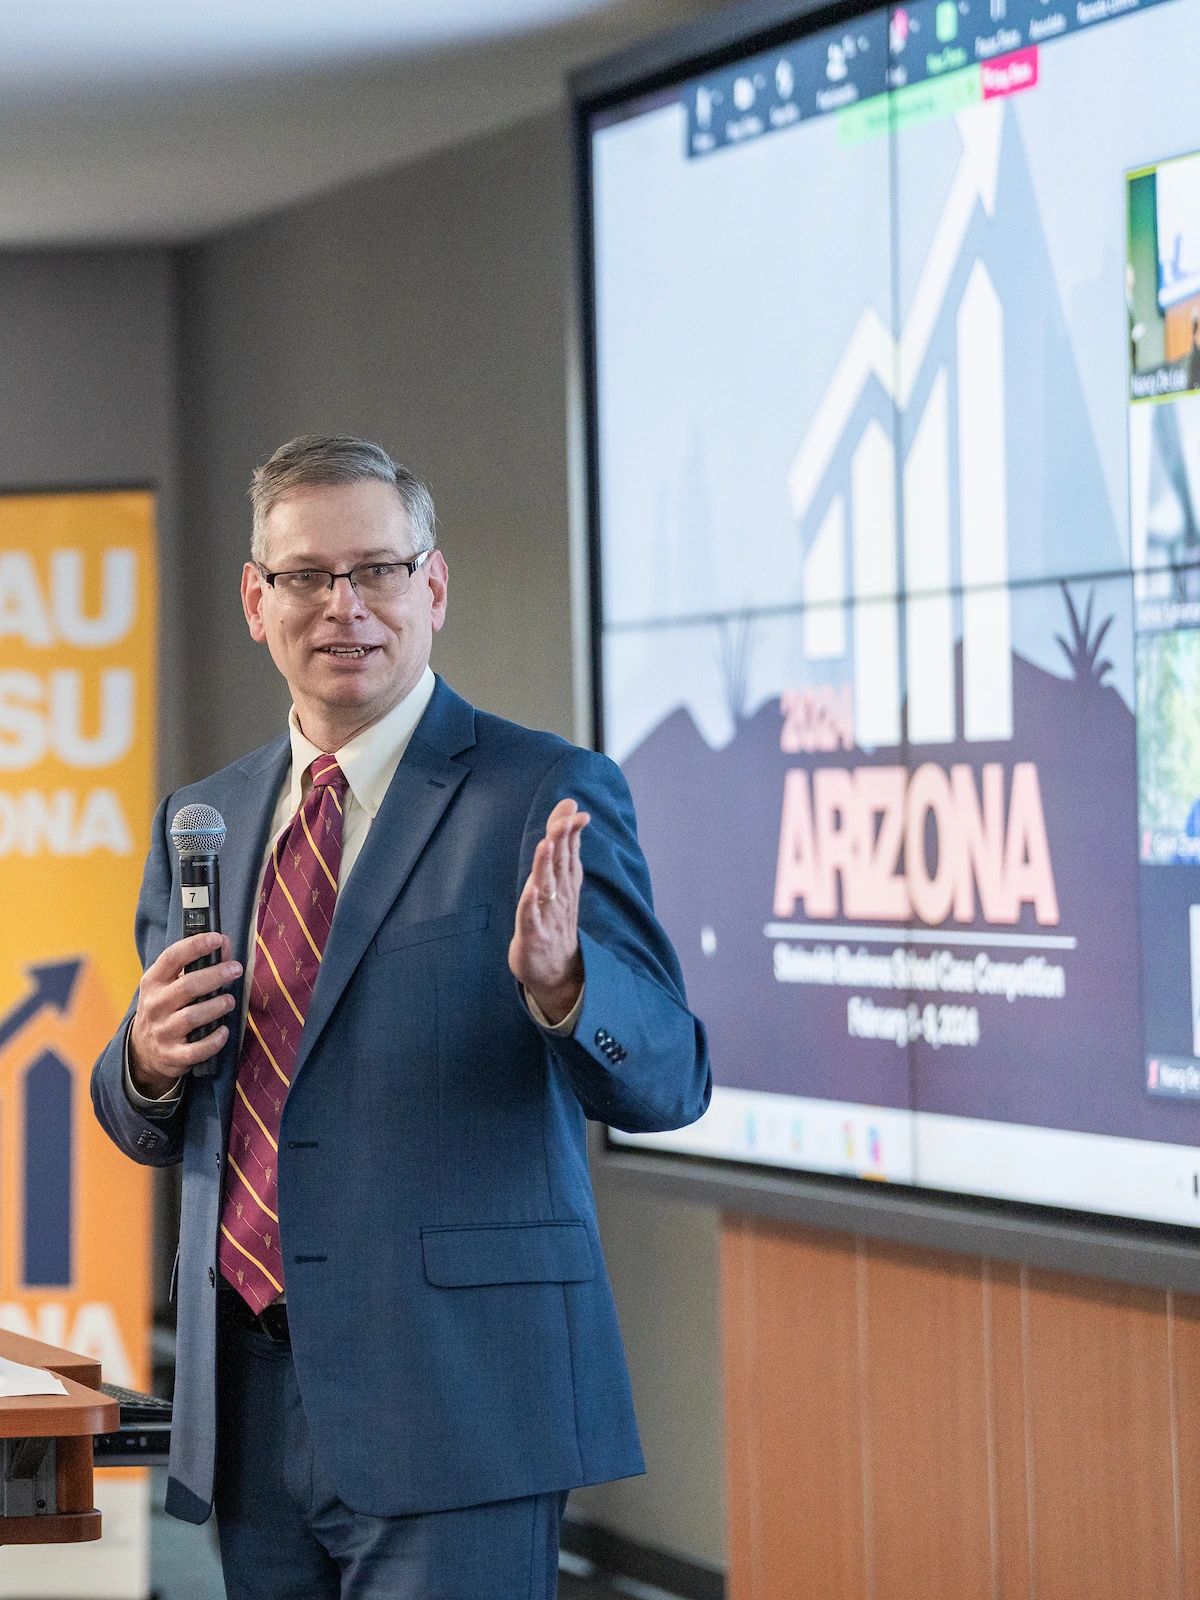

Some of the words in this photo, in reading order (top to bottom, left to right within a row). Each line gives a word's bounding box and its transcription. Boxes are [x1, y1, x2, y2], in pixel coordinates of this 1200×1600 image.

[779, 685, 854, 753] 2024
[773, 762, 1061, 926] ARIZONA
[189, 892, 196, 903] 7
